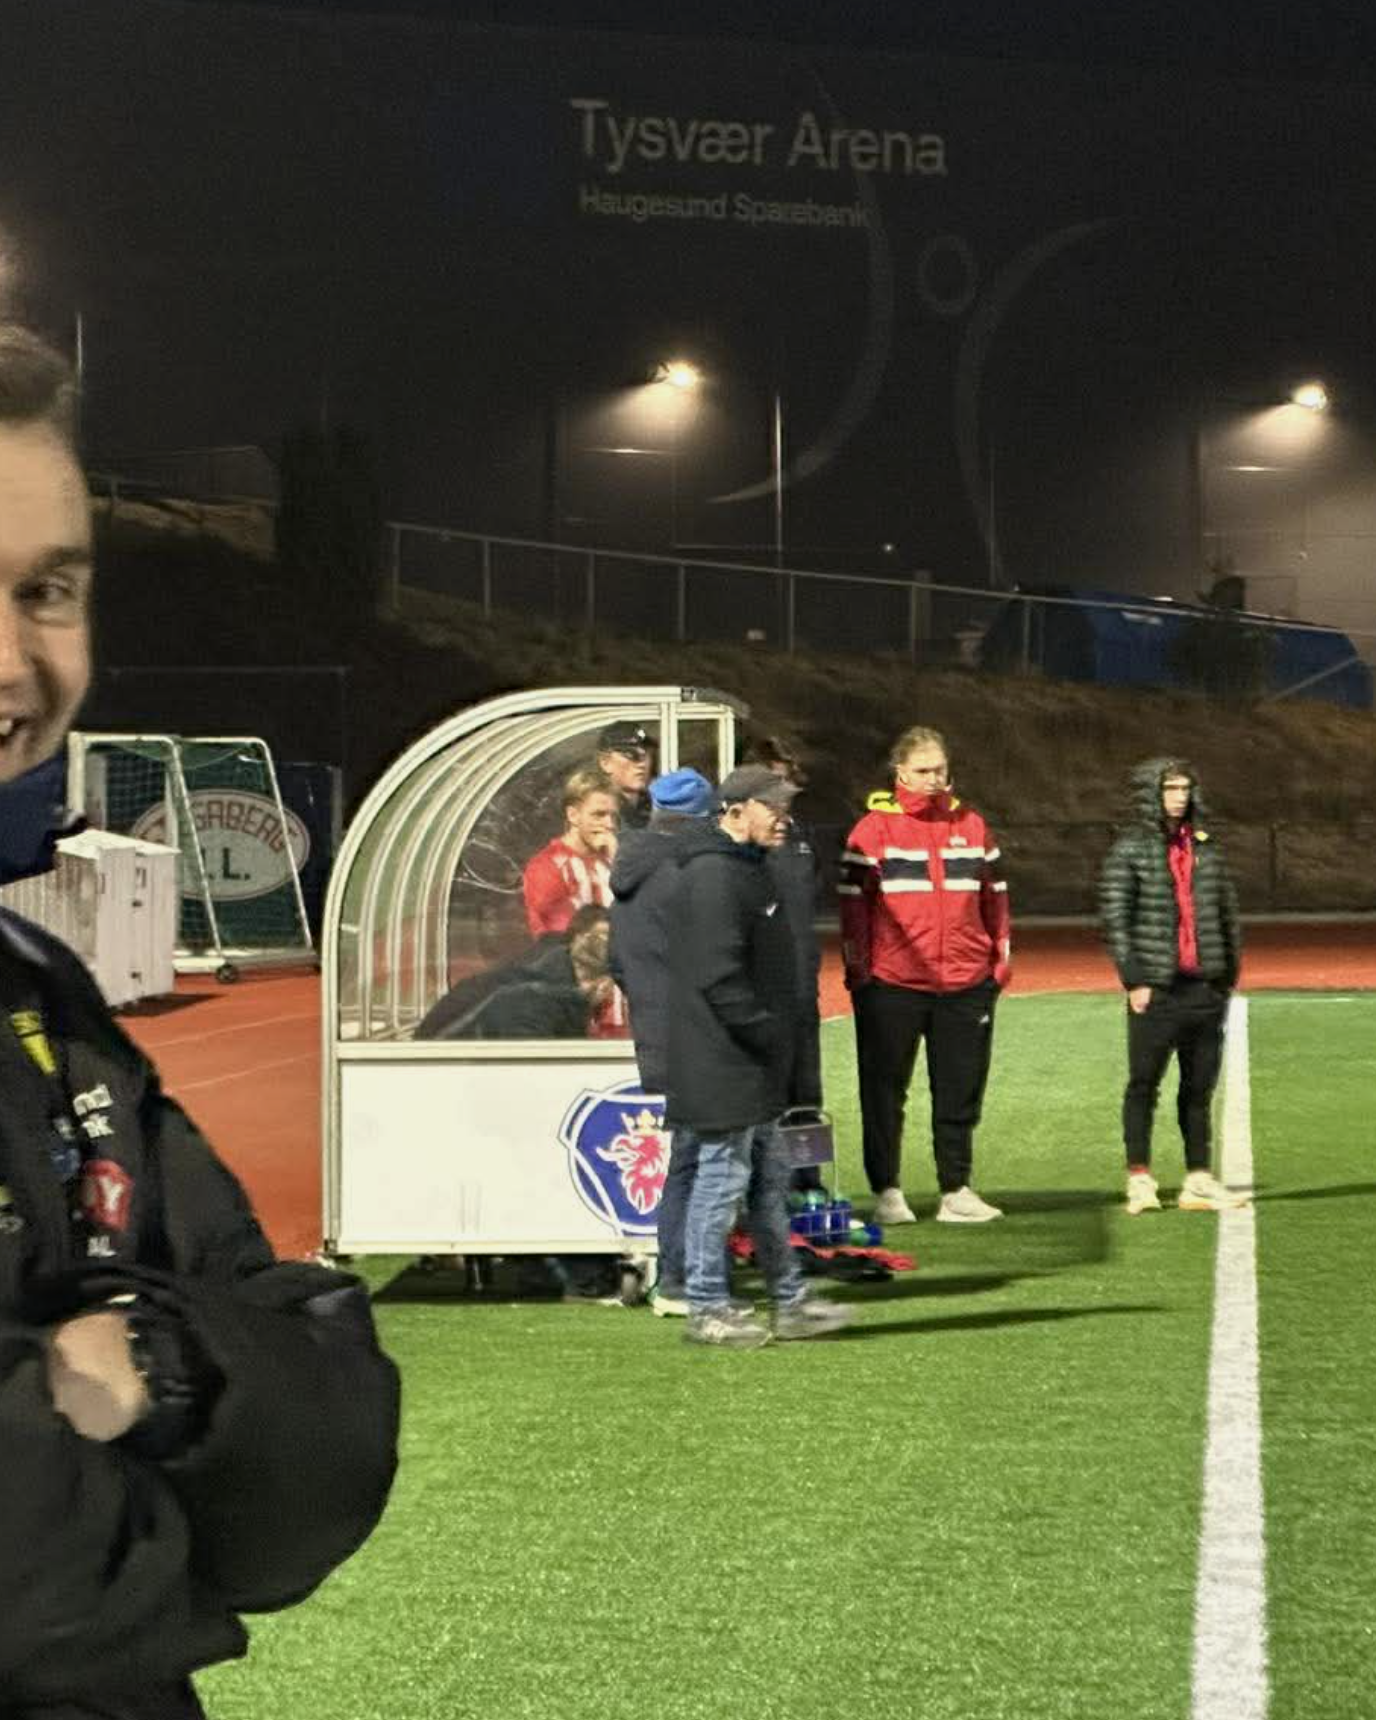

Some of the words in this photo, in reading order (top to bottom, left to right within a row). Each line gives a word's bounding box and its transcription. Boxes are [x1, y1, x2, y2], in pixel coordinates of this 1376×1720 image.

[570, 98, 773, 173] Tysvær
[787, 111, 947, 176] Arena
[579, 185, 727, 222] Haugesund
